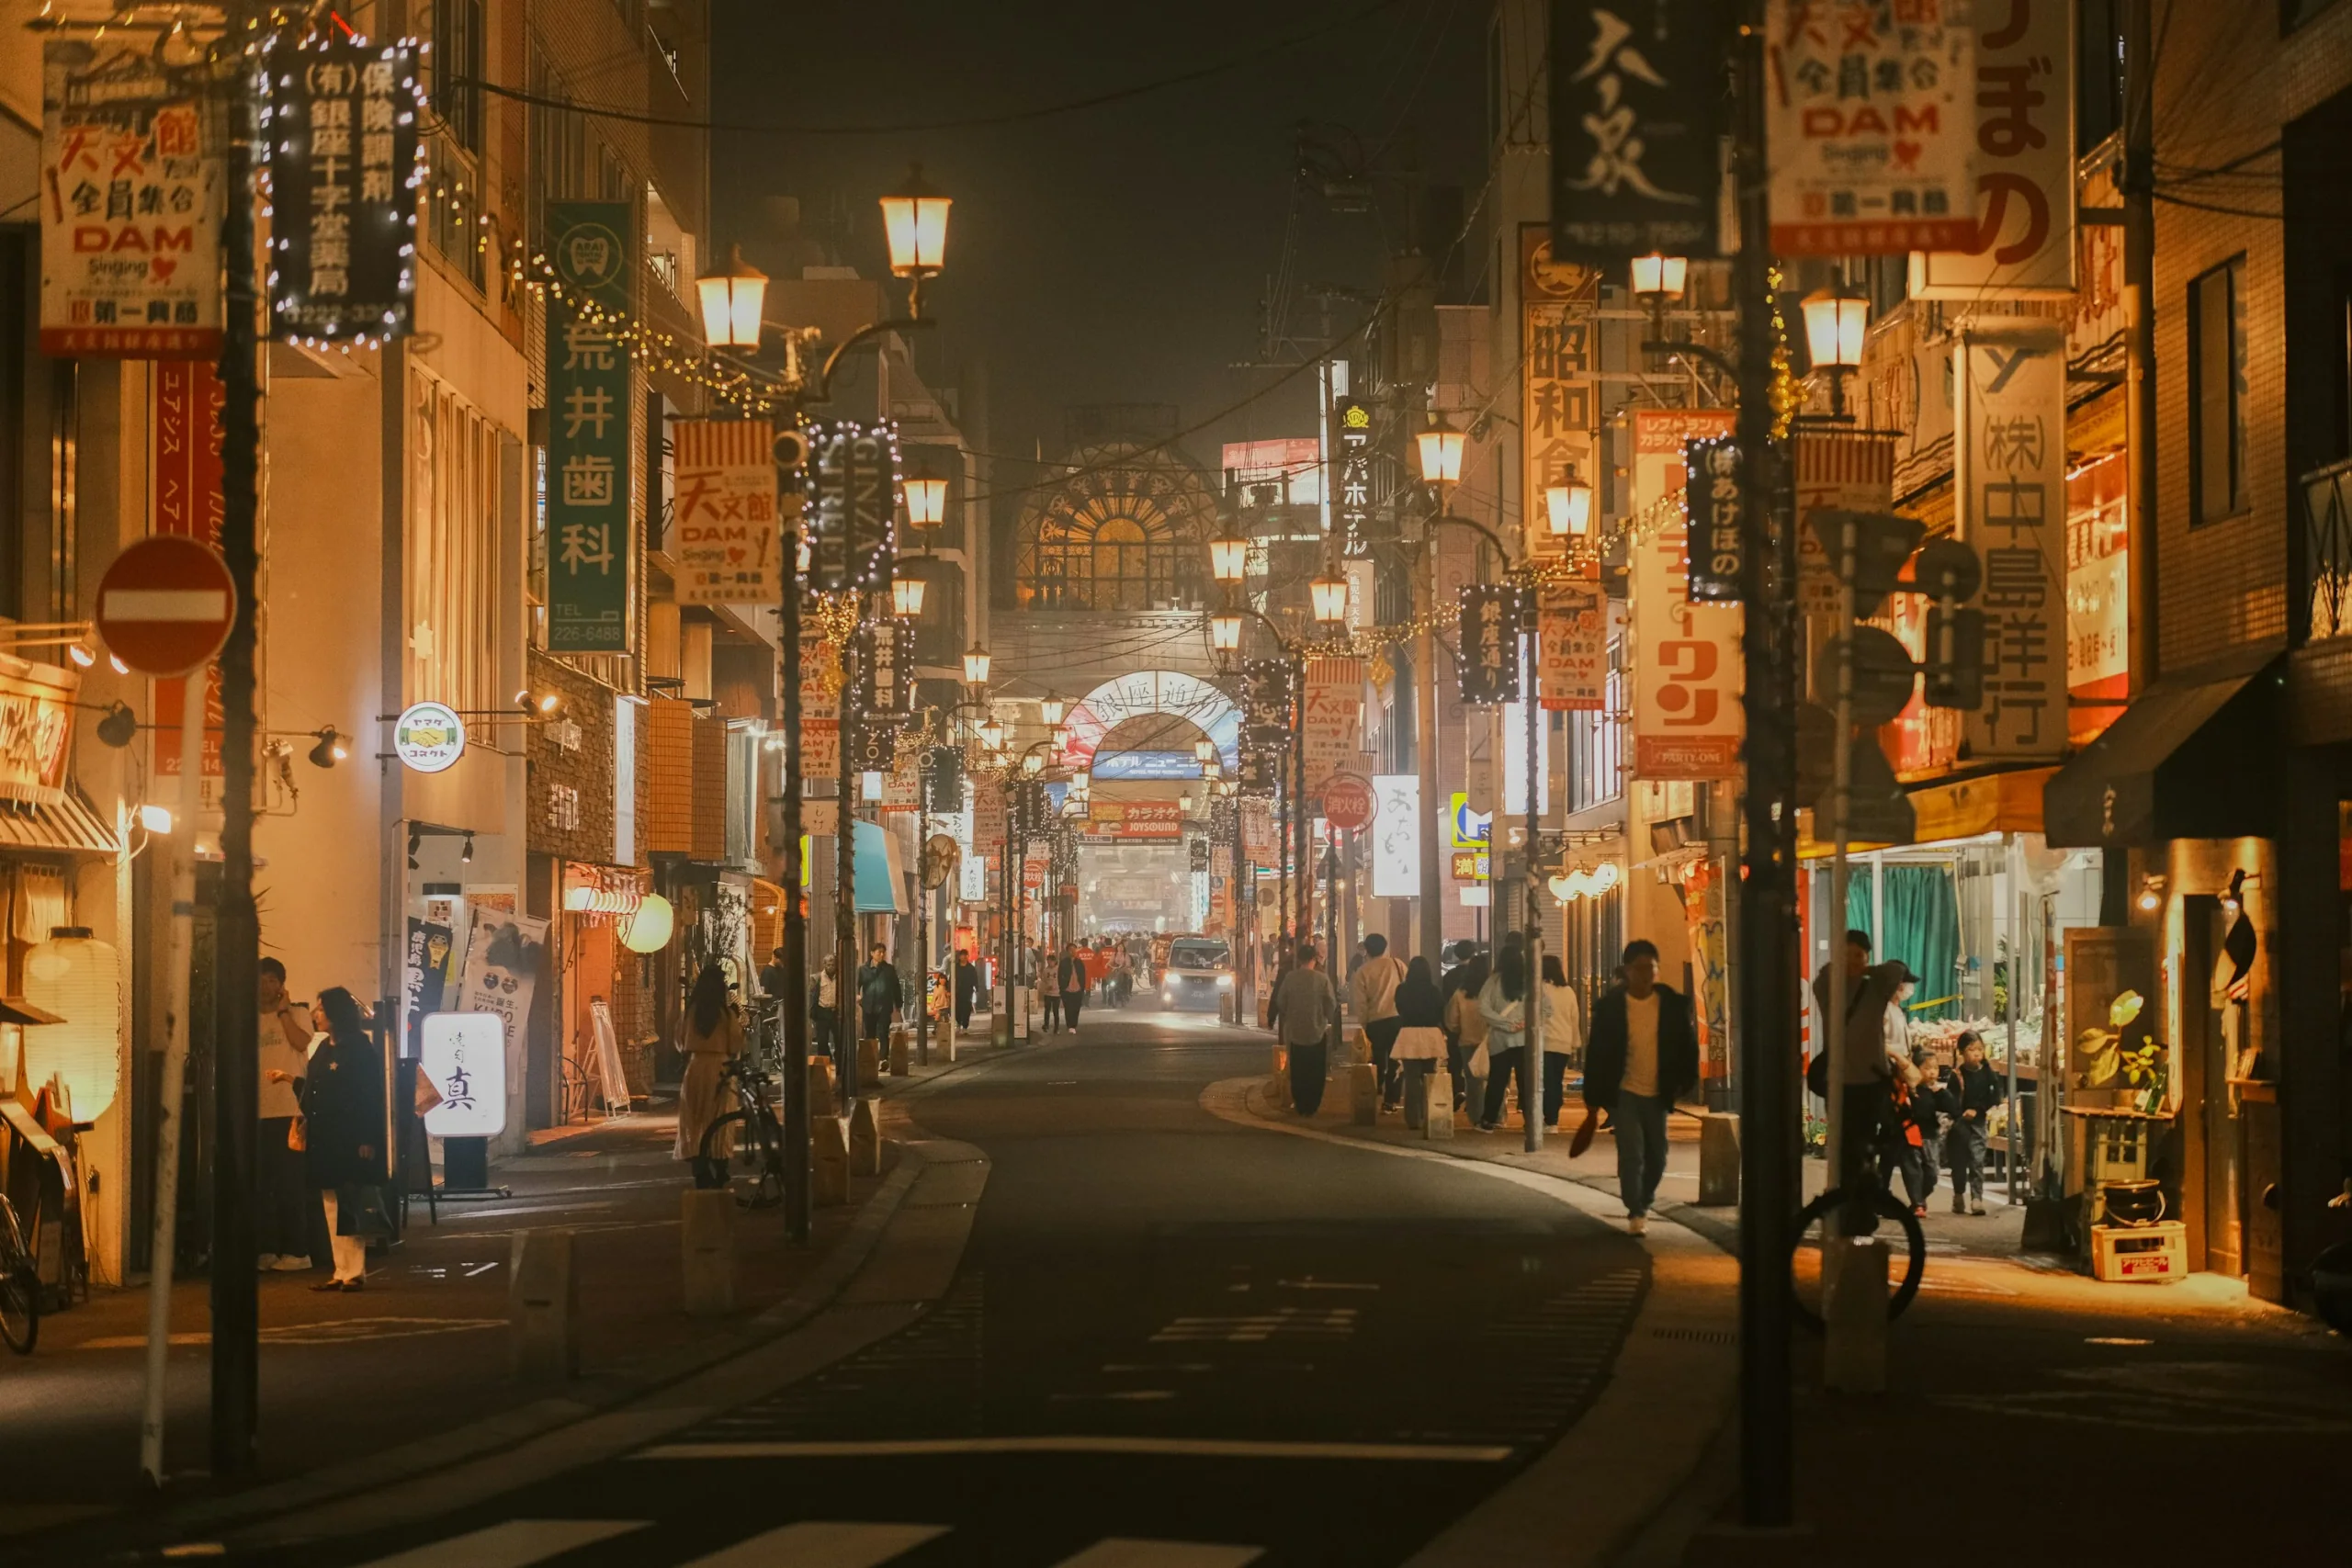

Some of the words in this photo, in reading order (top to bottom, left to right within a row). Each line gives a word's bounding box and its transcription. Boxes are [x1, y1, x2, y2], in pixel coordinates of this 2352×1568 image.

[1802, 105, 1939, 139] DAM
[1973, 0, 2051, 265] ぼの
[60, 107, 198, 176] 天文館
[70, 178, 194, 220] 全員集合
[74, 225, 193, 253] DAM
[87, 257, 149, 276] Singing
[1646, 418, 1712, 432] レストラン
[561, 323, 615, 576] 荒井歯科
[680, 469, 772, 522] 天文館
[853, 436, 879, 553] GINZA
[1343, 434, 1368, 556] アパホテル
[820, 438, 846, 582] STREET
[682, 526, 746, 542] DAM
[554, 604, 582, 616] TEL
[554, 626, 620, 641] 226-6488
[1480, 600, 1502, 689] 銀座通り
[1547, 639, 1596, 656] 全員集合
[875, 626, 894, 708] 荒井歯科
[1548, 658, 1595, 670] DAM
[1095, 680, 1220, 722] 銀座通り
[1306, 685, 1359, 715] 天文館
[1306, 716, 1342, 725] DAM
[1106, 756, 1140, 769] ホテル
[1145, 756, 1204, 769] ニューニシ
[1127, 807, 1179, 820] カラオケ
[1328, 796, 1366, 815] 消火栓
[1129, 822, 1178, 831] JOYSOUND
[1455, 858, 1474, 875] 満
[442, 1066, 477, 1111] 真
[2122, 1257, 2169, 1268] アサヒビール
